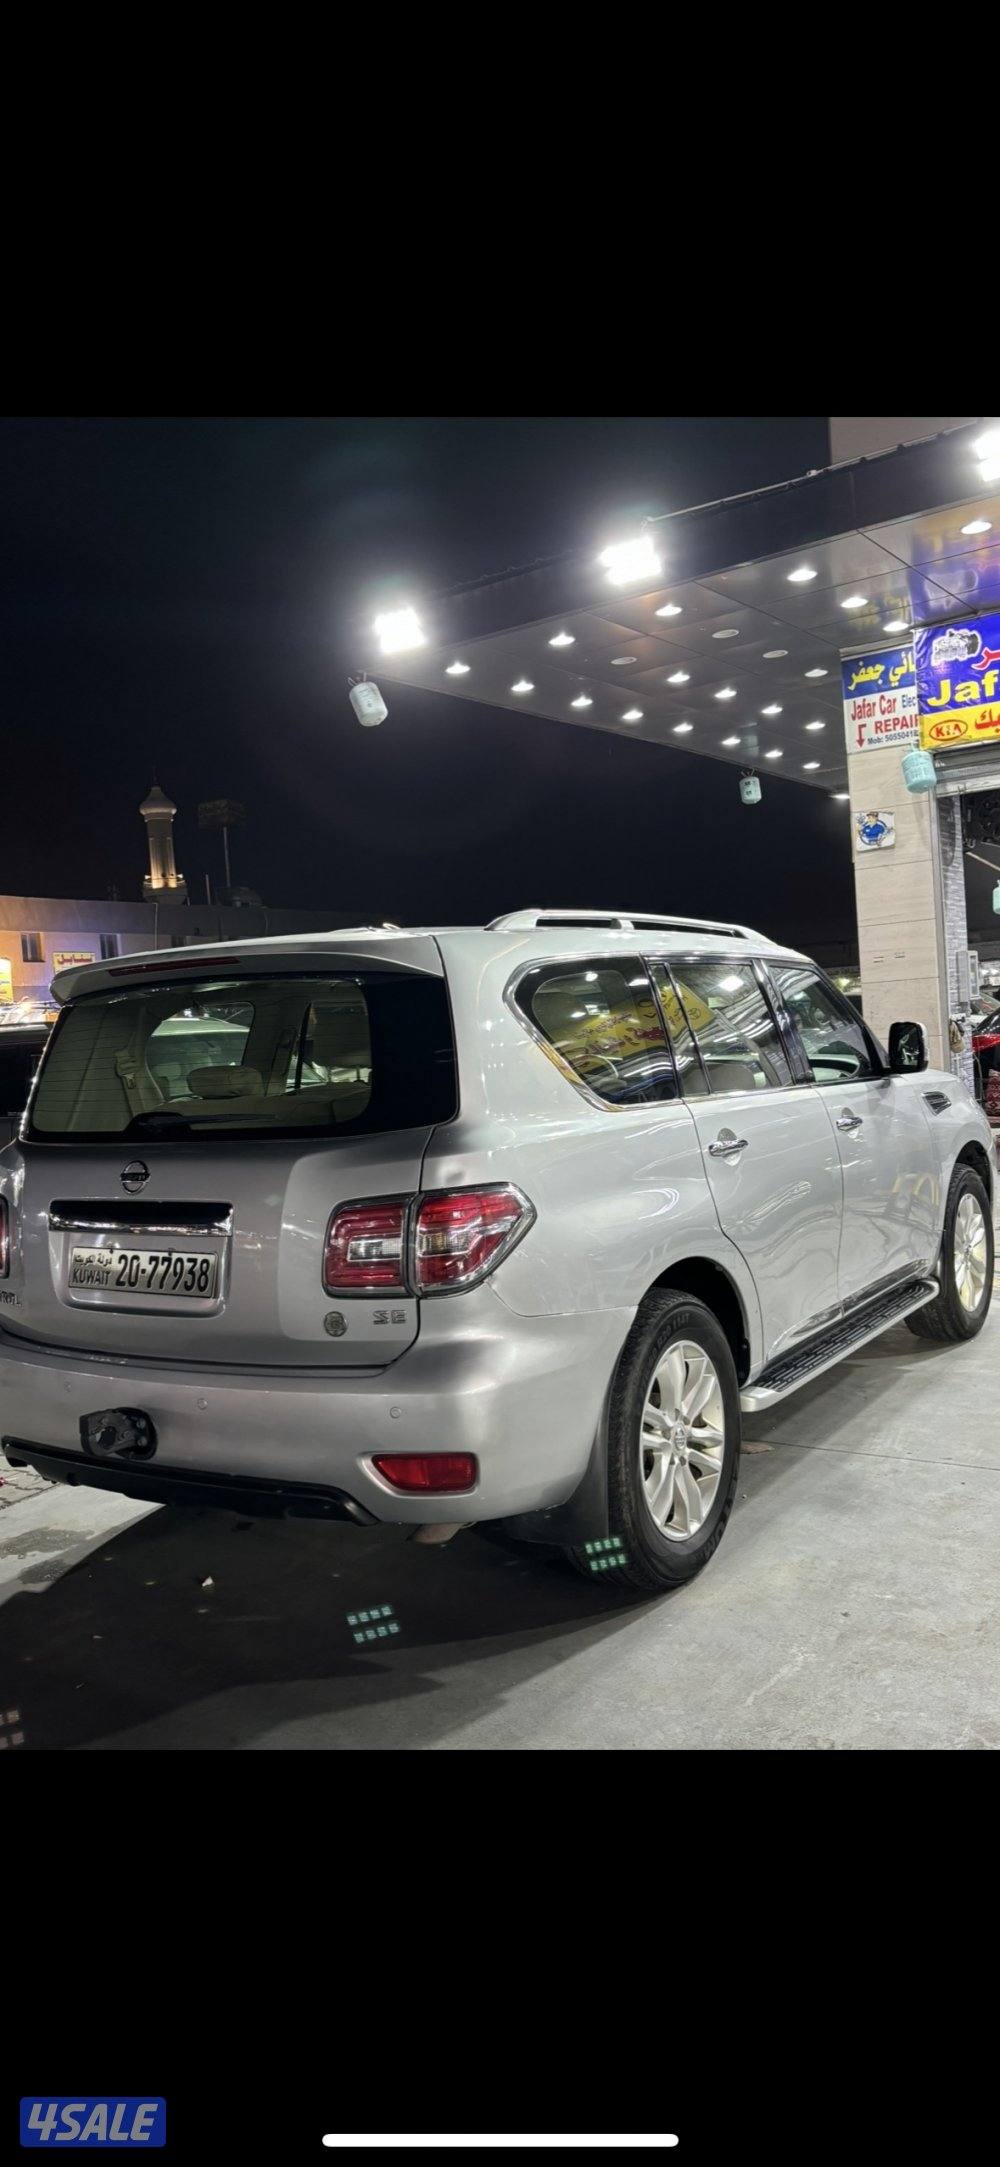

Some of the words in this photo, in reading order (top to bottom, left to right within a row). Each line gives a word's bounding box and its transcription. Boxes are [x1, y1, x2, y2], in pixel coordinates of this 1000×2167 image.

[848, 661, 885, 691] جعفر
[851, 697, 877, 721] Jafar
[879, 694, 897, 715] Car
[72, 1267, 111, 1286] KUWAIT
[373, 1309, 406, 1325] SE
